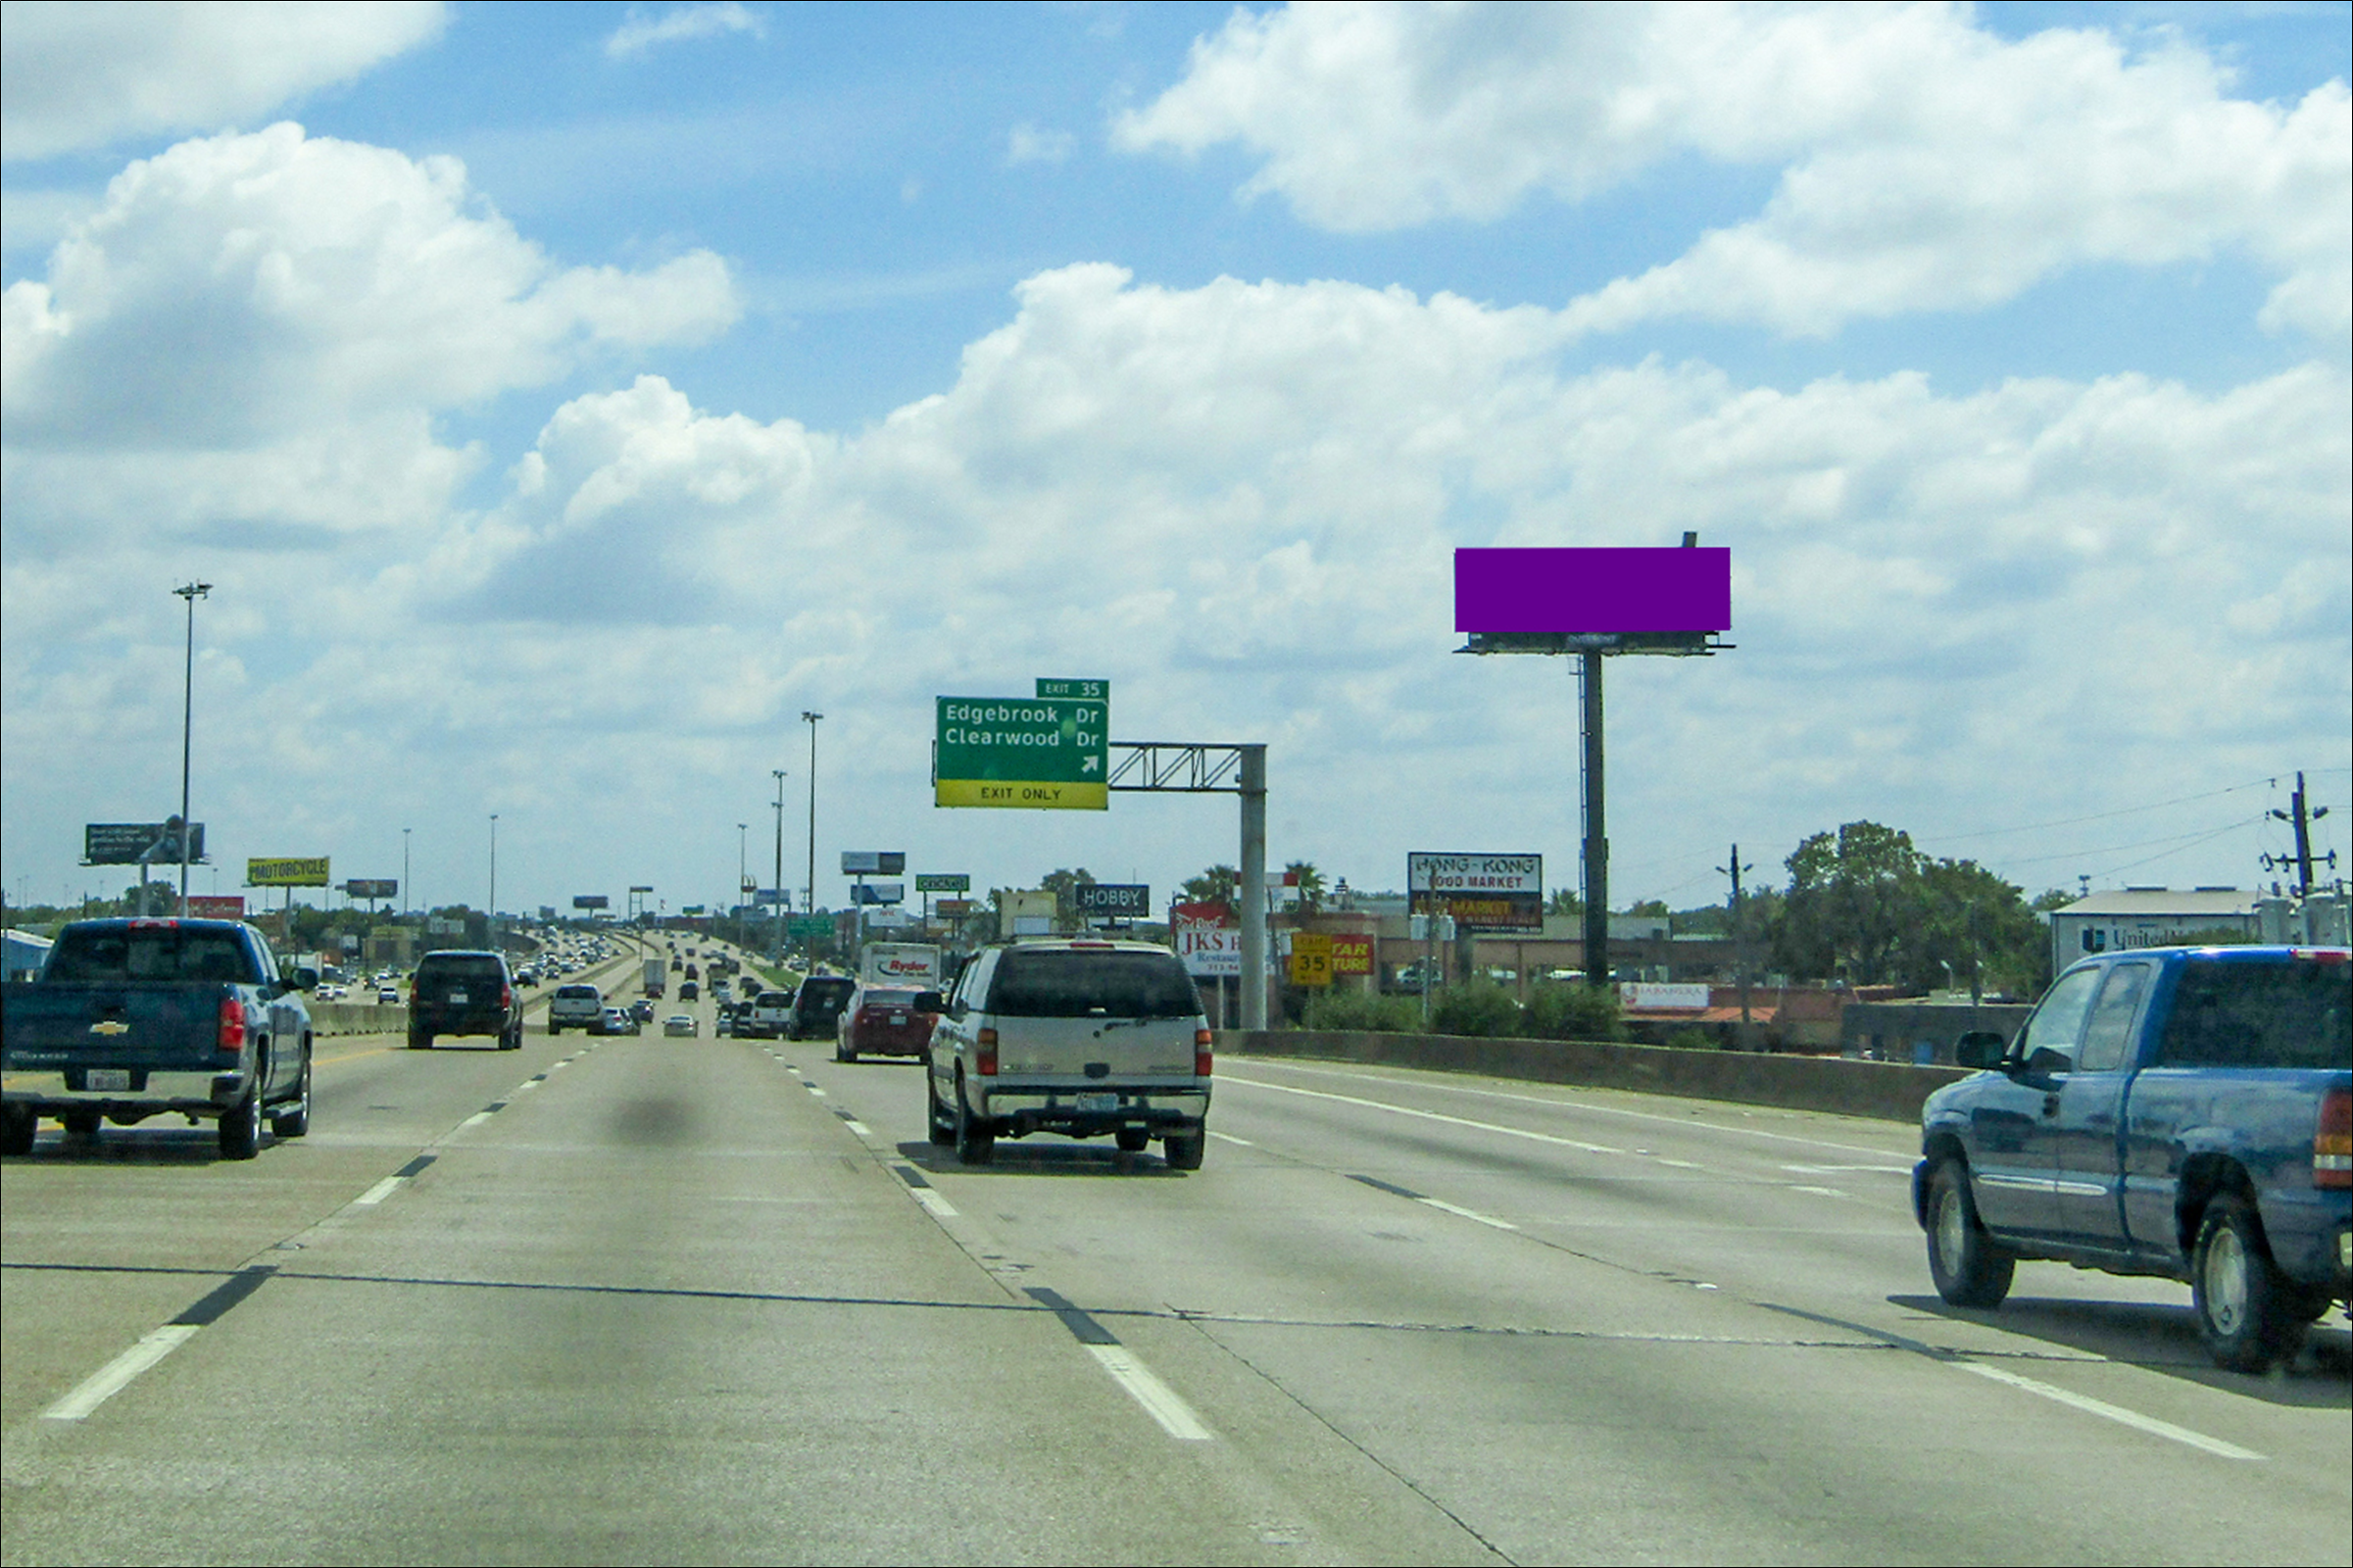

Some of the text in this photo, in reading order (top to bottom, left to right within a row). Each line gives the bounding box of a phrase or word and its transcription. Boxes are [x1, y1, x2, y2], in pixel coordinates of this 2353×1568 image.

[1045, 682, 1101, 697] EXIT 35
[946, 705, 1100, 725] Edgebrook Dr
[946, 728, 1100, 747] Clearwood Dr
[981, 787, 1062, 801] EXIT ONLY
[255, 858, 326, 880] MOTORCYCLE
[1468, 876, 1523, 889] MARKET
[1084, 889, 1141, 906] HOBBY
[1182, 933, 1224, 956] JKS
[2113, 928, 2168, 950] United
[890, 959, 929, 972] Ryder
[1299, 956, 1326, 971] 35
